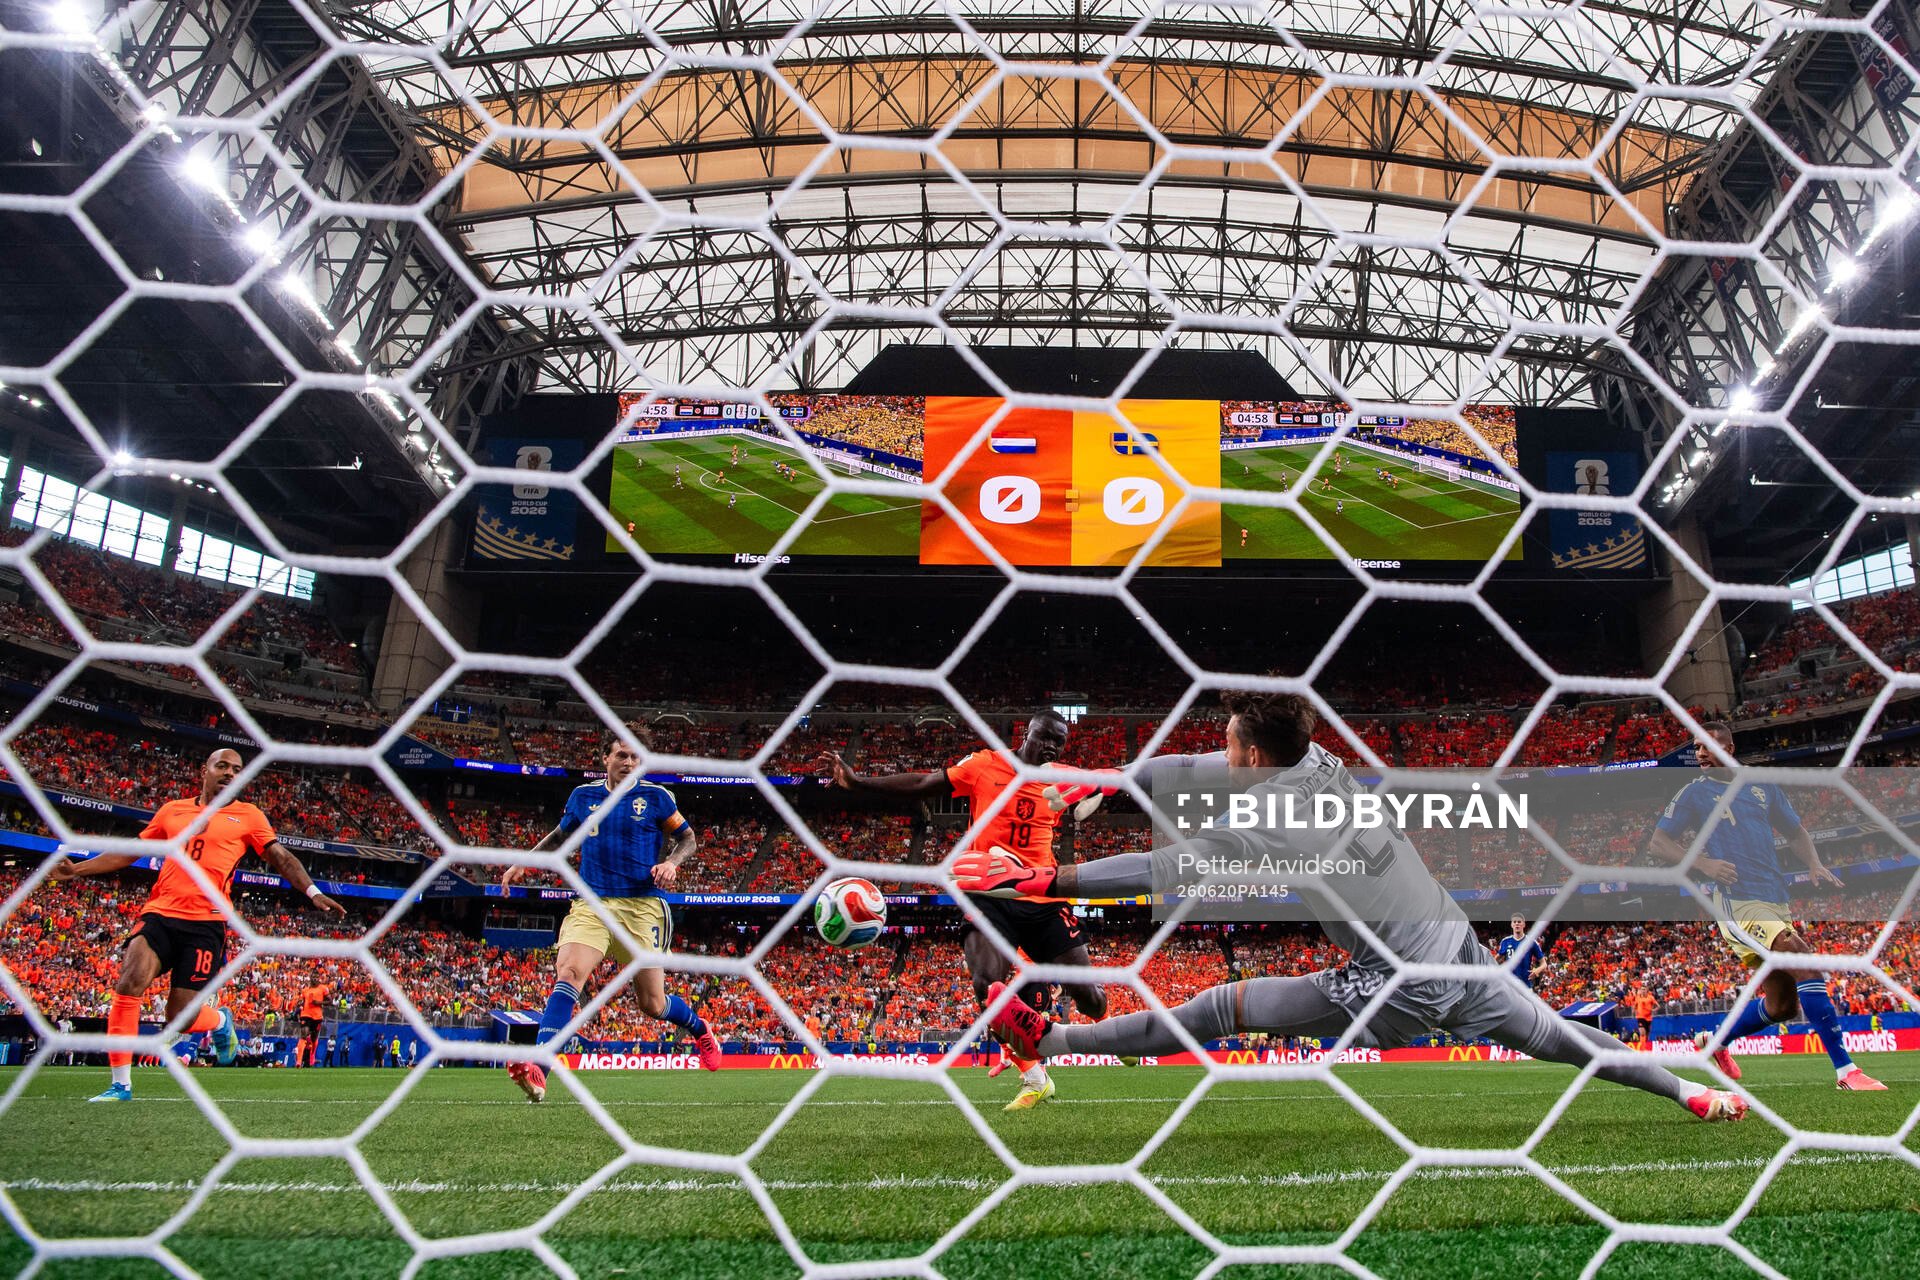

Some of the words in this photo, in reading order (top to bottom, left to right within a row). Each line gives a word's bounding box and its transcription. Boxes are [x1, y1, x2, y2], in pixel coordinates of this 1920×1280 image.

[1885, 72, 1909, 100] 2015
[636, 405, 668, 416] 4:58
[703, 406, 719, 416] NED
[726, 407, 732, 416] 0
[751, 407, 757, 416] 0
[1237, 413, 1268, 424] 04:58
[1303, 415, 1318, 423] NED
[1325, 415, 1331, 424] 0
[1361, 416, 1378, 424] SWE
[885, 467, 917, 483] AMERICA
[523, 487, 539, 495] FIFA
[511, 507, 547, 516] 2026
[1578, 517, 1612, 526] 2026
[218, 733, 232, 743] FIFA
[232, 736, 255, 747] WORLD
[1815, 744, 1830, 753] FIFA
[62, 795, 113, 812] HOUSTON
[1009, 822, 1031, 848] 19
[288, 838, 302, 846] CUP
[301, 840, 325, 850] 2026
[241, 873, 281, 886] HOUSTON
[684, 895, 703, 904] FIFA
[704, 895, 733, 904] WORLD
[733, 895, 751, 904] CUP
[751, 896, 781, 904] 2026
[651, 925, 660, 949] 3
[194, 948, 213, 975] 18
[1036, 991, 1042, 1003] 8
[578, 1053, 701, 1070] McDonald's
